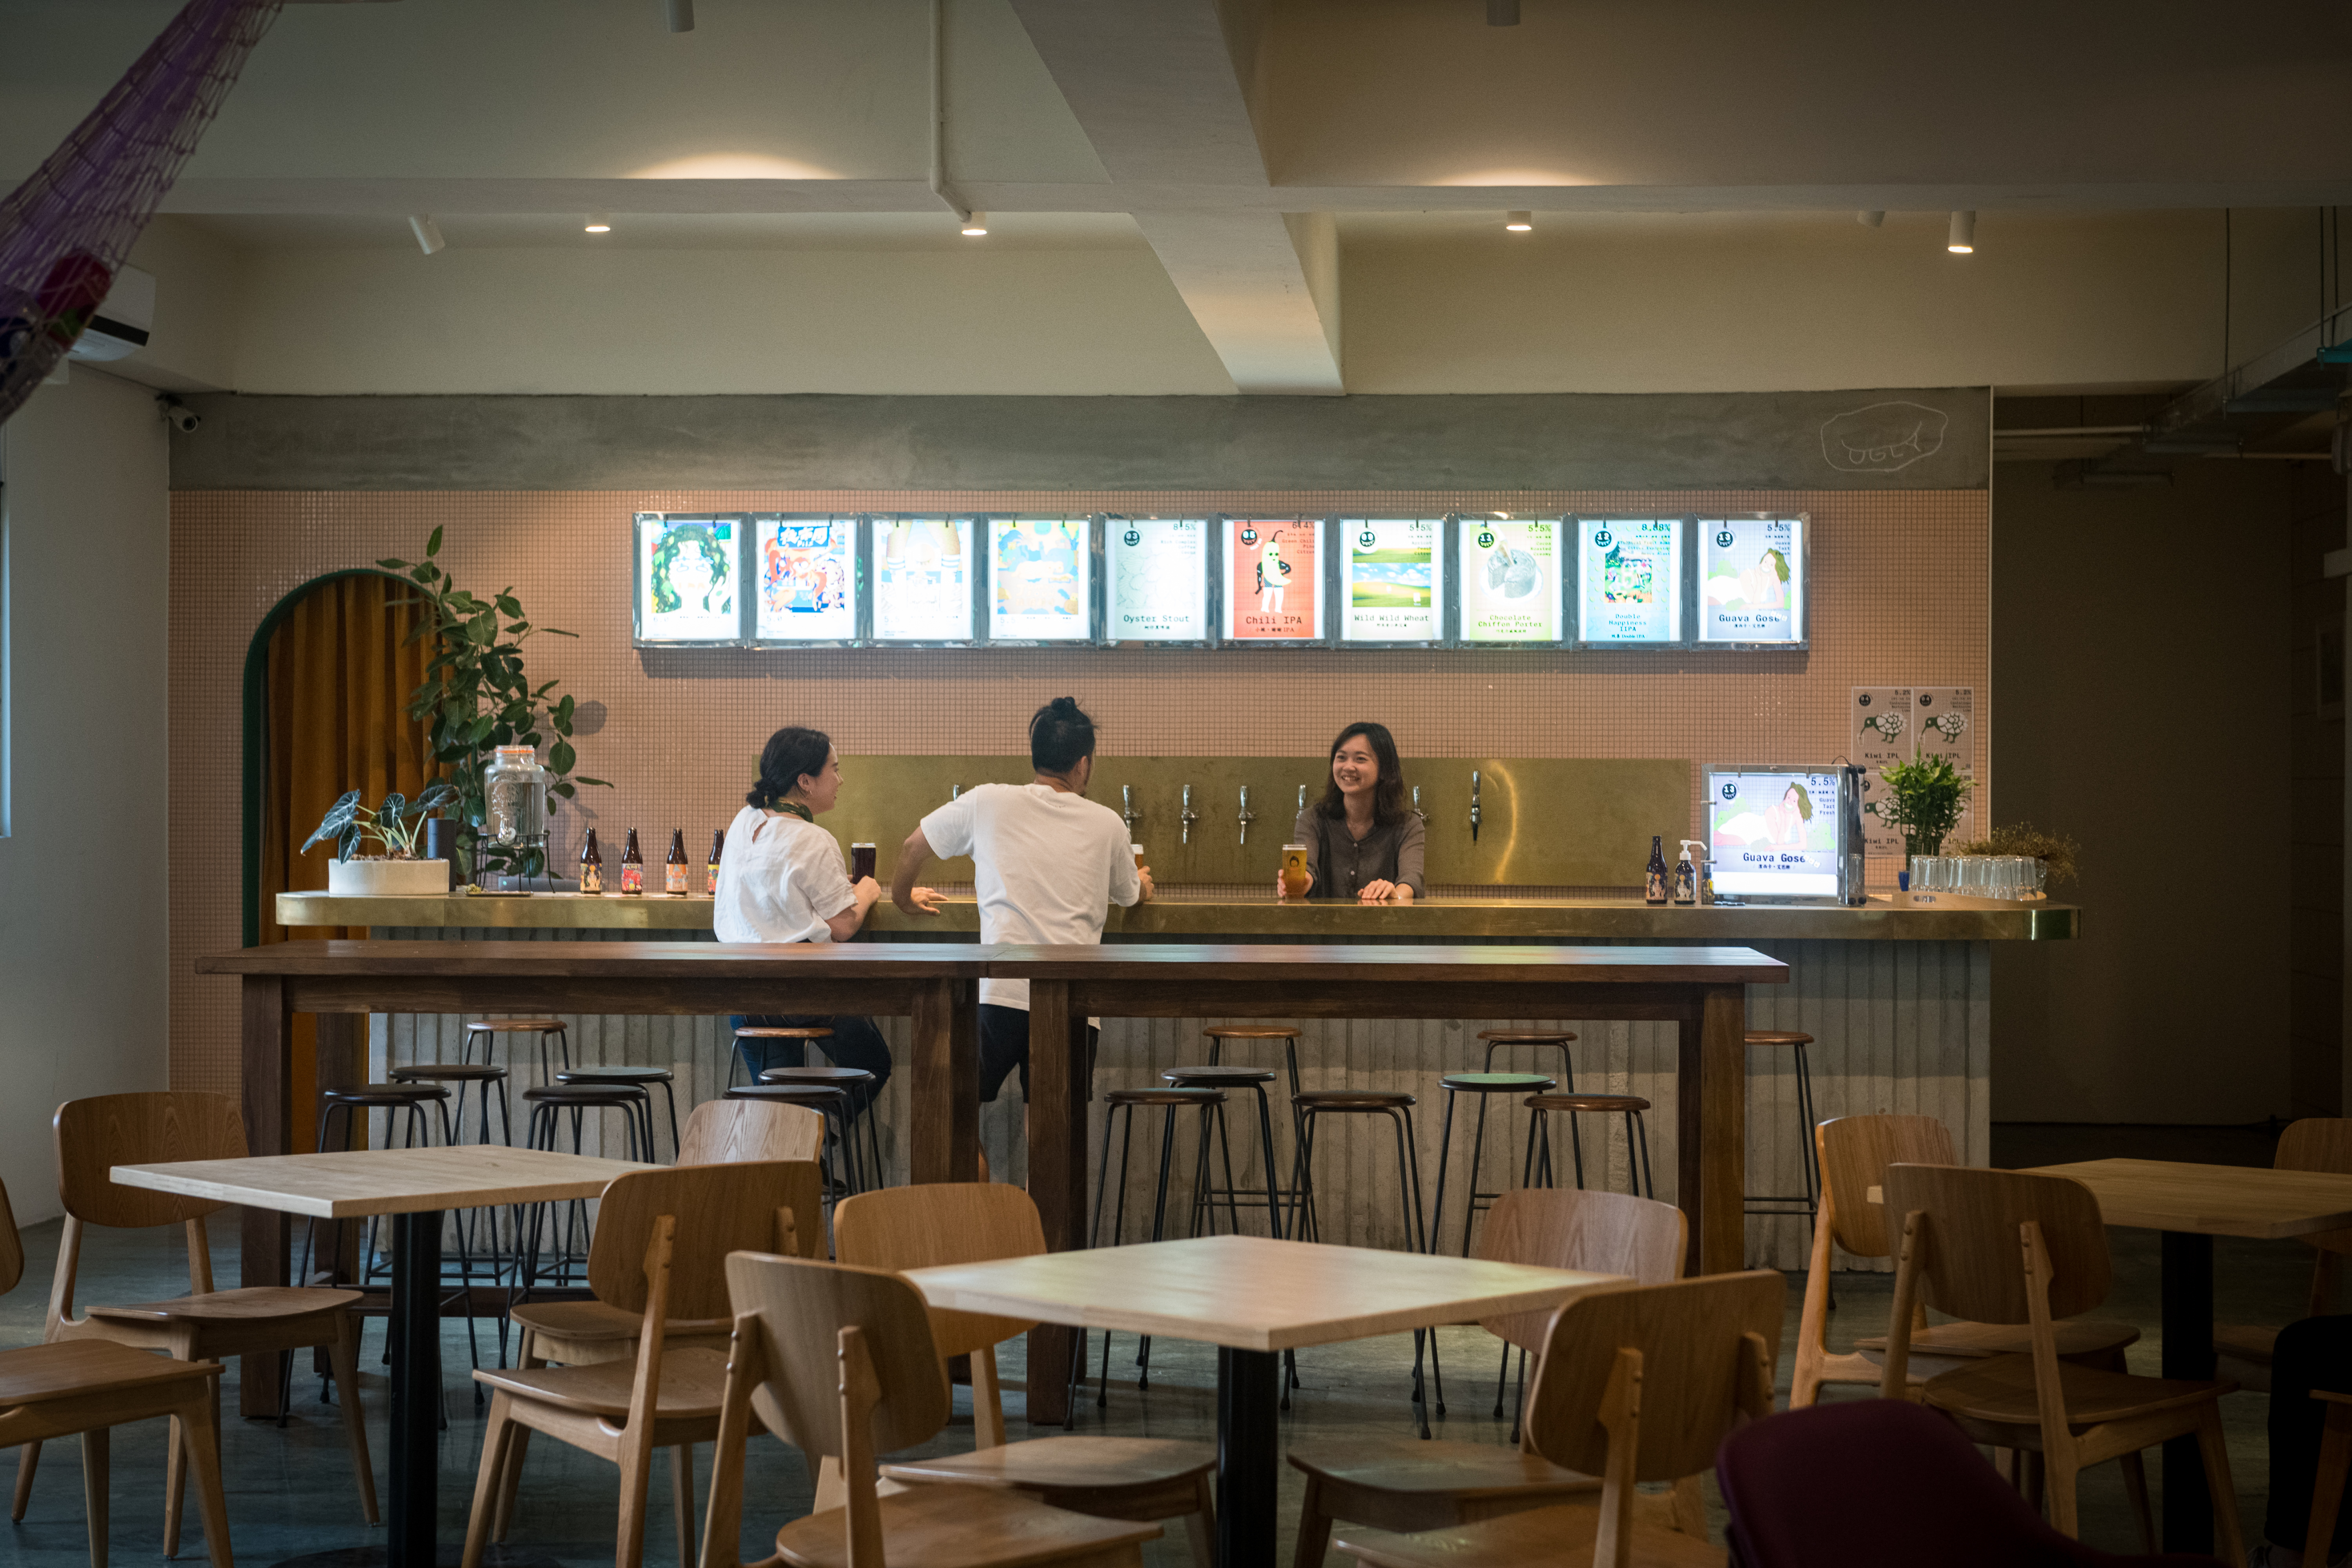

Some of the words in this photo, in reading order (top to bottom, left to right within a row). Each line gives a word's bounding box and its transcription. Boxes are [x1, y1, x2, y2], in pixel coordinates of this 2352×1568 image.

[1123, 615, 1156, 623] Oyster
[1811, 777, 1835, 786] 5.5%
[1743, 853, 1774, 862] Guava
[1781, 853, 1806, 862] Gose
